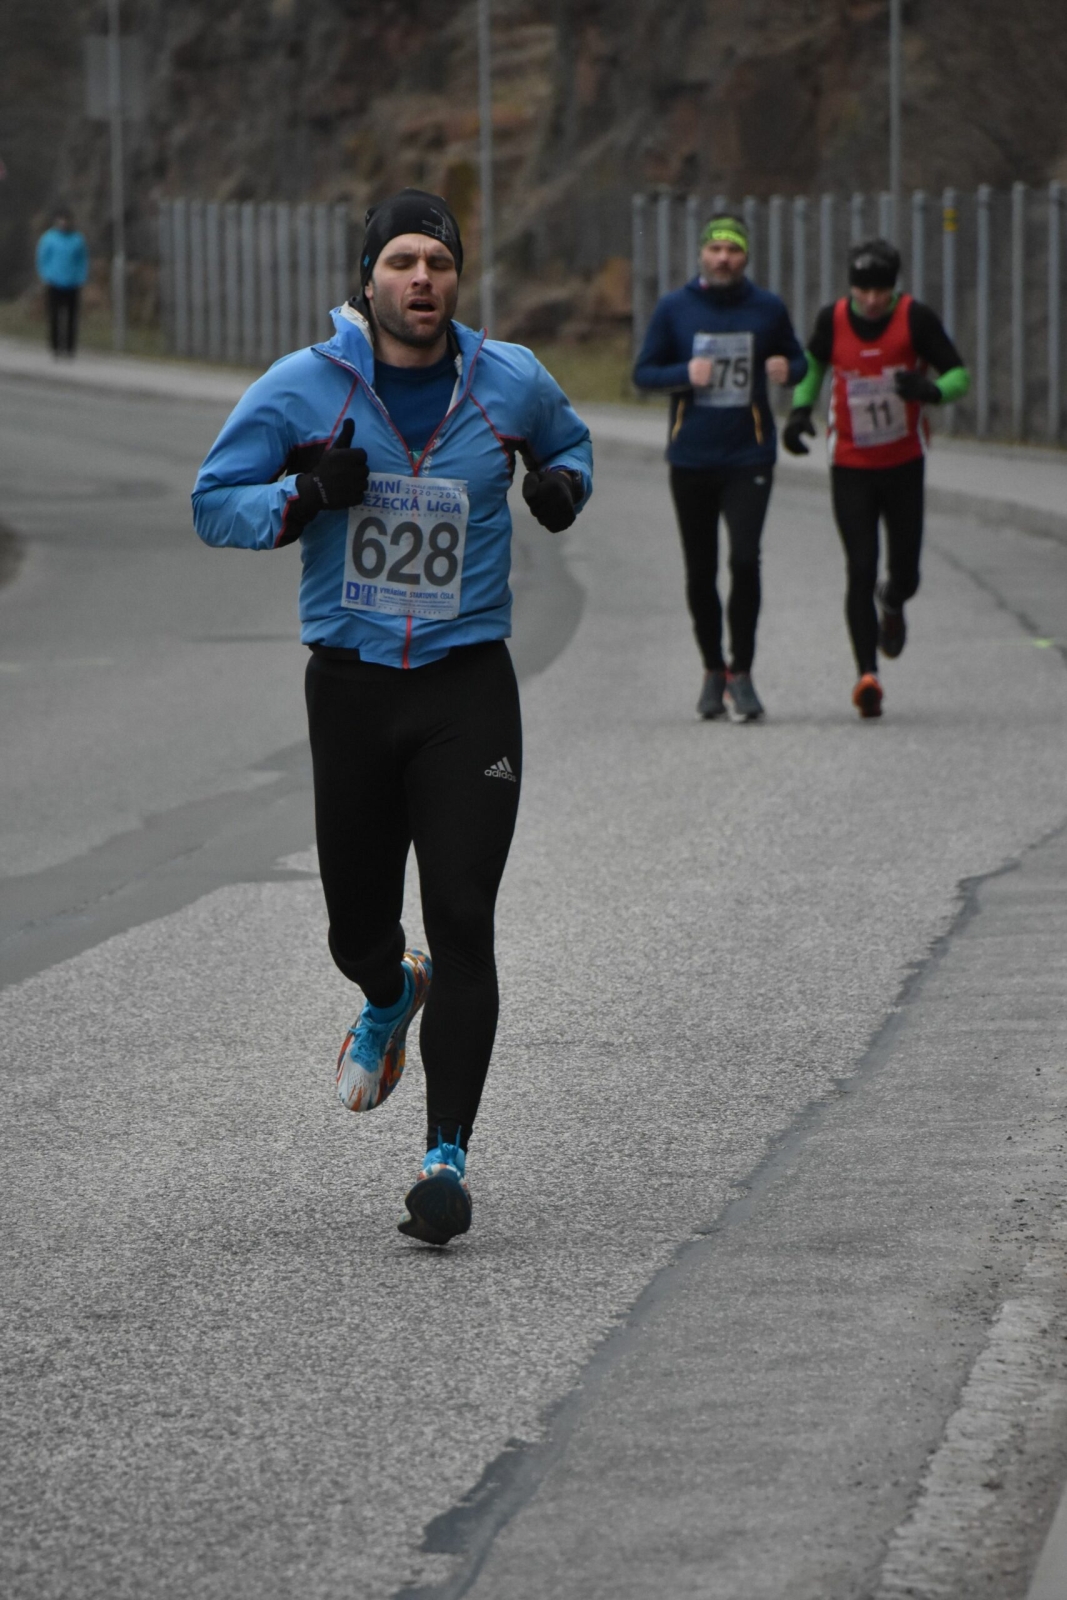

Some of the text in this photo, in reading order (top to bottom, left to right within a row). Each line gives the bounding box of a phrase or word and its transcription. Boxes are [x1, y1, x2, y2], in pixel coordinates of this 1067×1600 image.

[709, 358, 749, 390] 75
[865, 400, 892, 429] 11
[368, 479, 403, 494] MNÍ
[362, 493, 420, 511] ĚŽECKÁ
[427, 500, 462, 514] LIGA
[352, 516, 460, 587] 628
[484, 769, 517, 783] adidas
